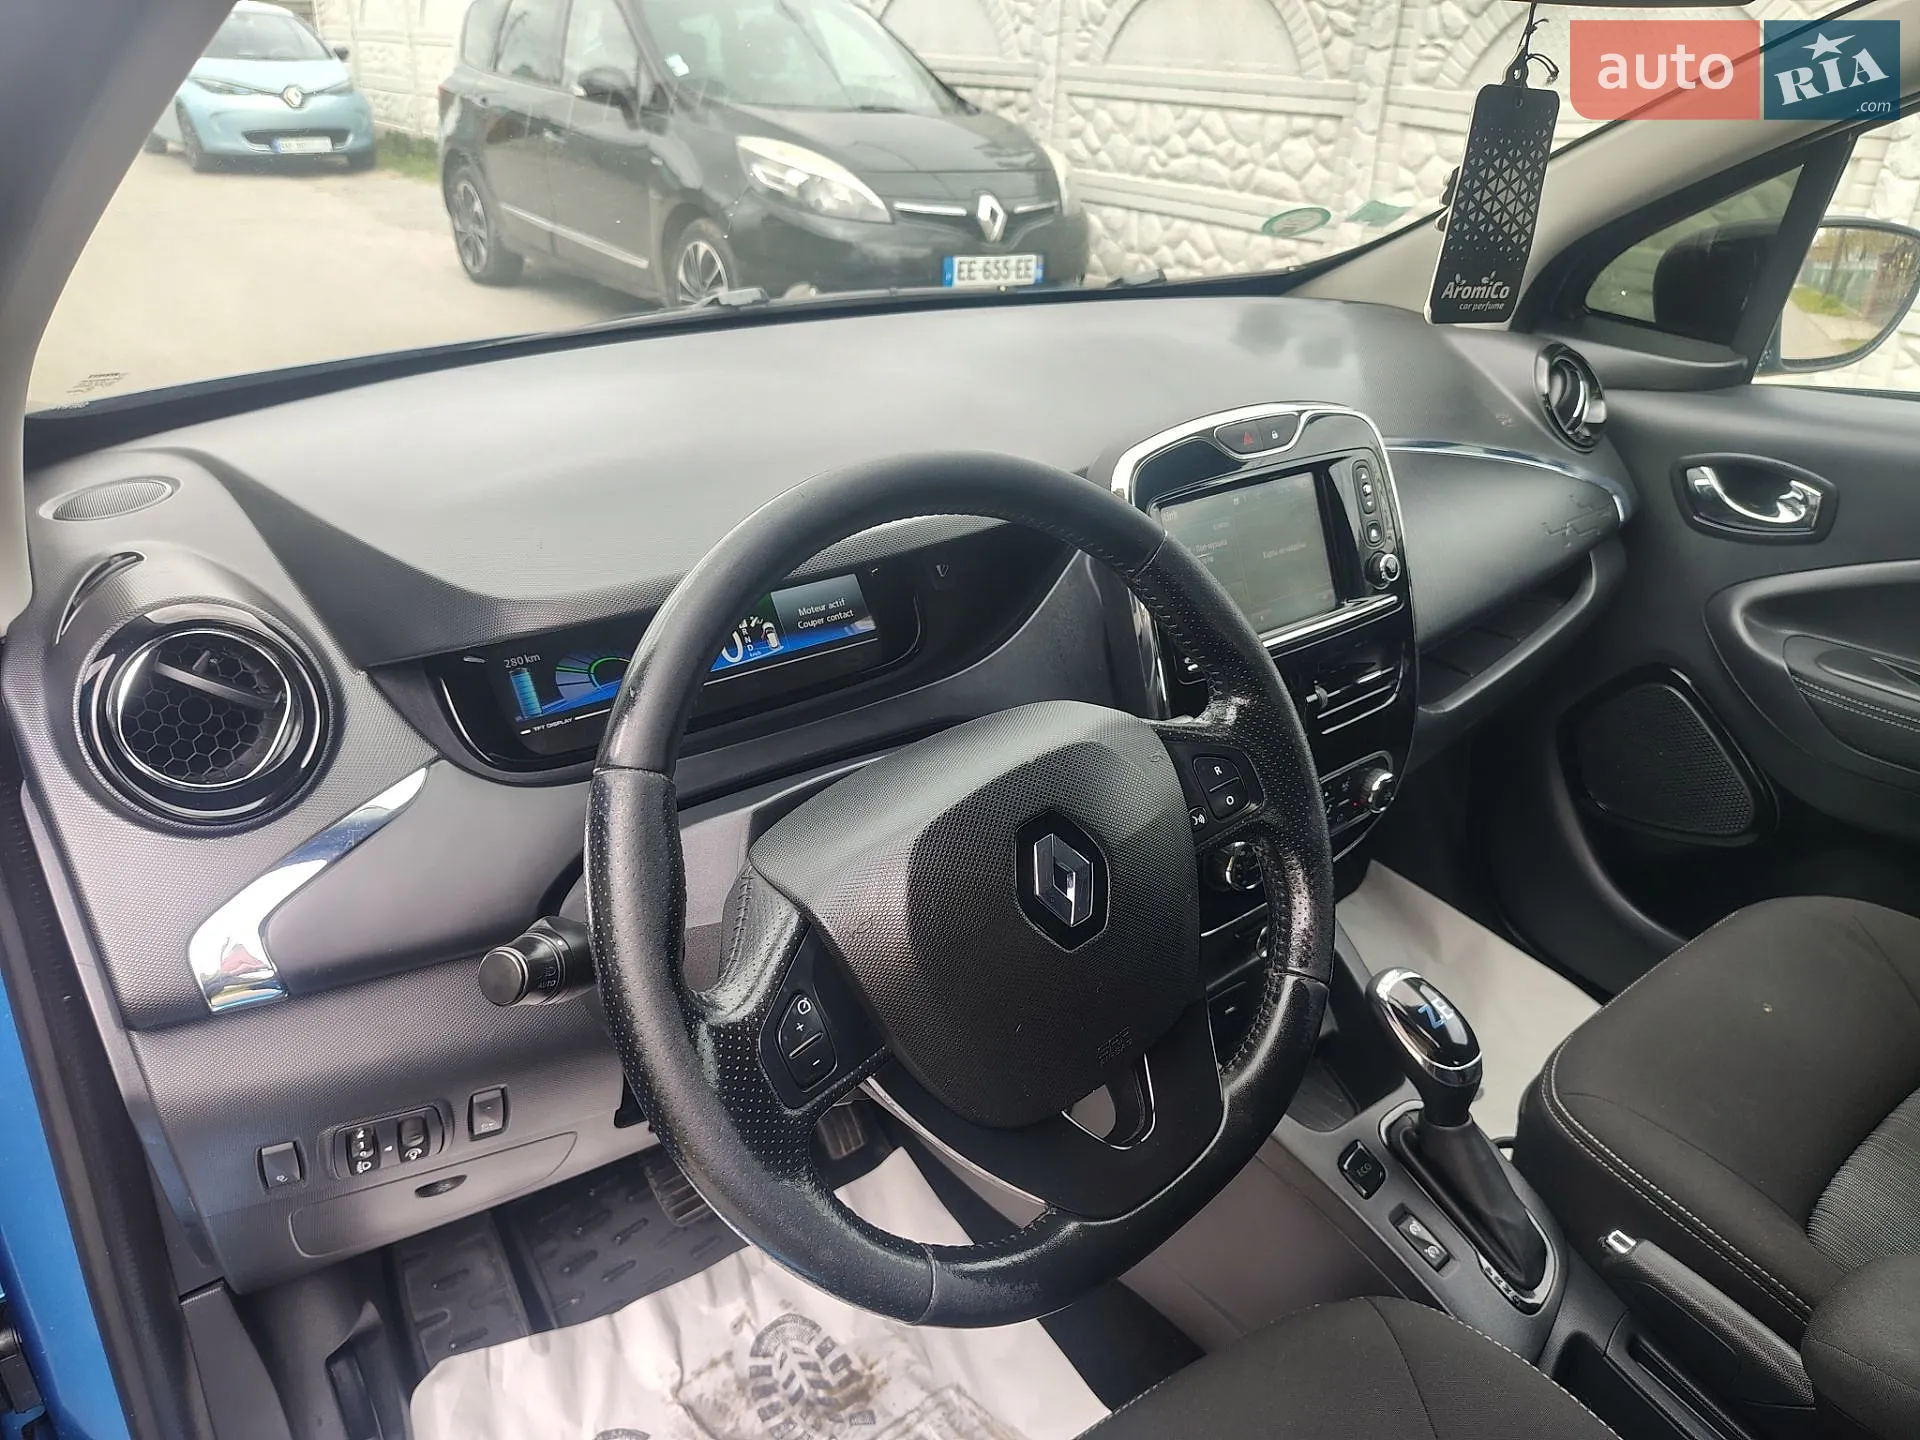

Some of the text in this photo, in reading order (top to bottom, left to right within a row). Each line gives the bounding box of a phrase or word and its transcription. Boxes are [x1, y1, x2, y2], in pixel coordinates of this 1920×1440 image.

[1440, 281, 1511, 299] AromiCo
[1472, 302, 1505, 312] perfume
[798, 598, 846, 617] Moteur actif
[797, 609, 854, 630] Couper contact
[503, 653, 541, 669] 280 km
[533, 717, 574, 732] TFT DISPLAY
[1213, 766, 1223, 776] R
